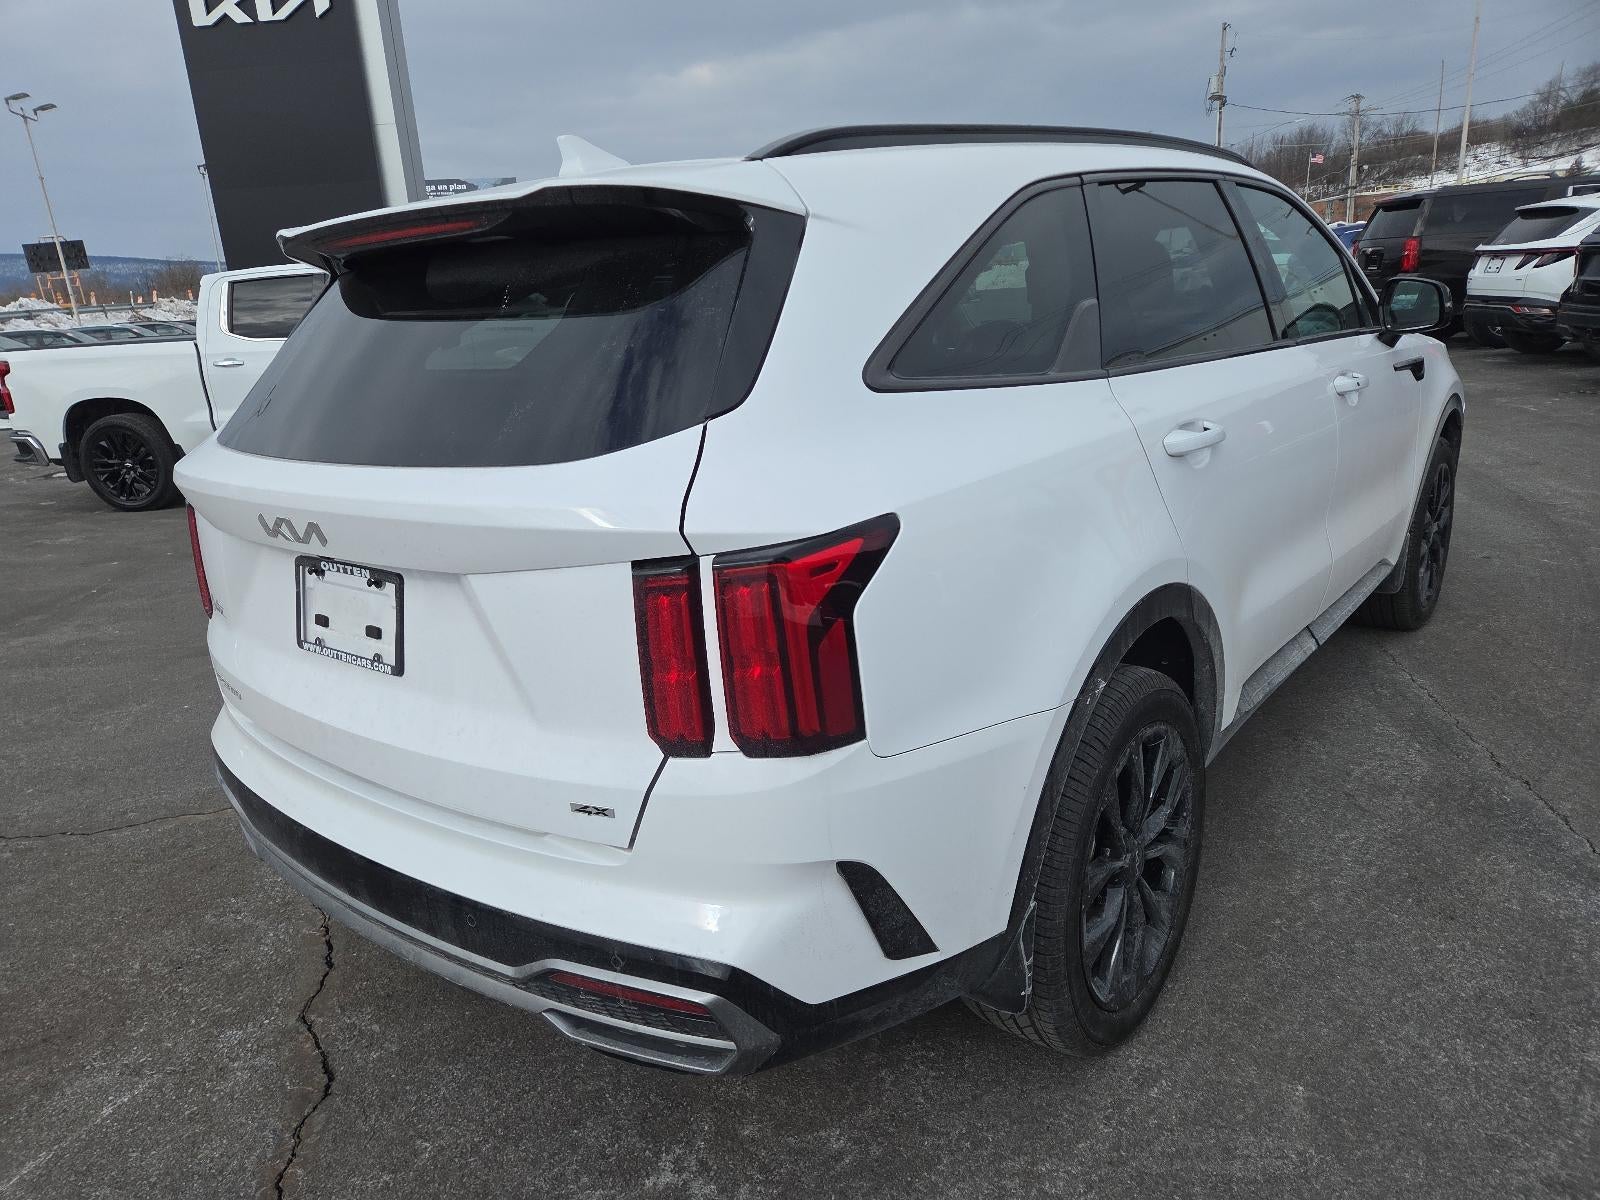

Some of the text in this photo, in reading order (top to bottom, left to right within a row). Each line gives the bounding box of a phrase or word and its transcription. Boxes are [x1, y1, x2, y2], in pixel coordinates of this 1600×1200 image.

[449, 183, 467, 191] plan
[257, 512, 328, 547] KIA
[320, 561, 371, 579] OUTTEN
[302, 641, 392, 675] WWW.OUTTENCARS.COM
